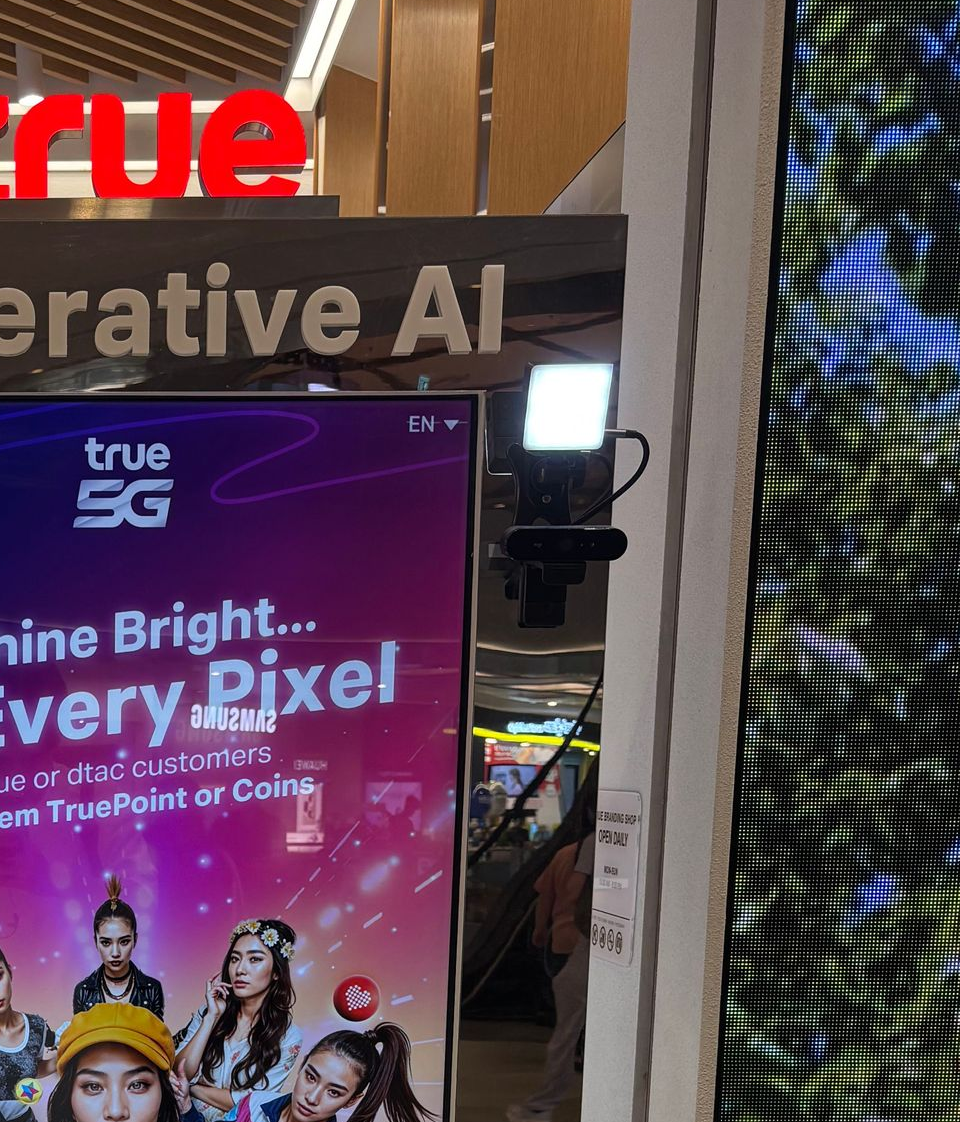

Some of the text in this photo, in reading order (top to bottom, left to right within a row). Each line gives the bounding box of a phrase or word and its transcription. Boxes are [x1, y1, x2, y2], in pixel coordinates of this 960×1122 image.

[391, 264, 505, 356] AI
[408, 416, 435, 433] EN
[85, 437, 171, 471] true
[73, 479, 174, 528] 5G
[114, 598, 317, 655] Bright...
[208, 640, 397, 719] Pixel
[33, 770, 60, 790] or
[67, 761, 125, 787] dtac
[132, 744, 272, 779] customers
[46, 790, 188, 825] TruePoint
[195, 786, 225, 807] or
[233, 773, 315, 803] Coins
[604, 811, 624, 823] BRANDING
[625, 813, 637, 825] SHOP
[598, 829, 629, 847] OPEN DAILY
